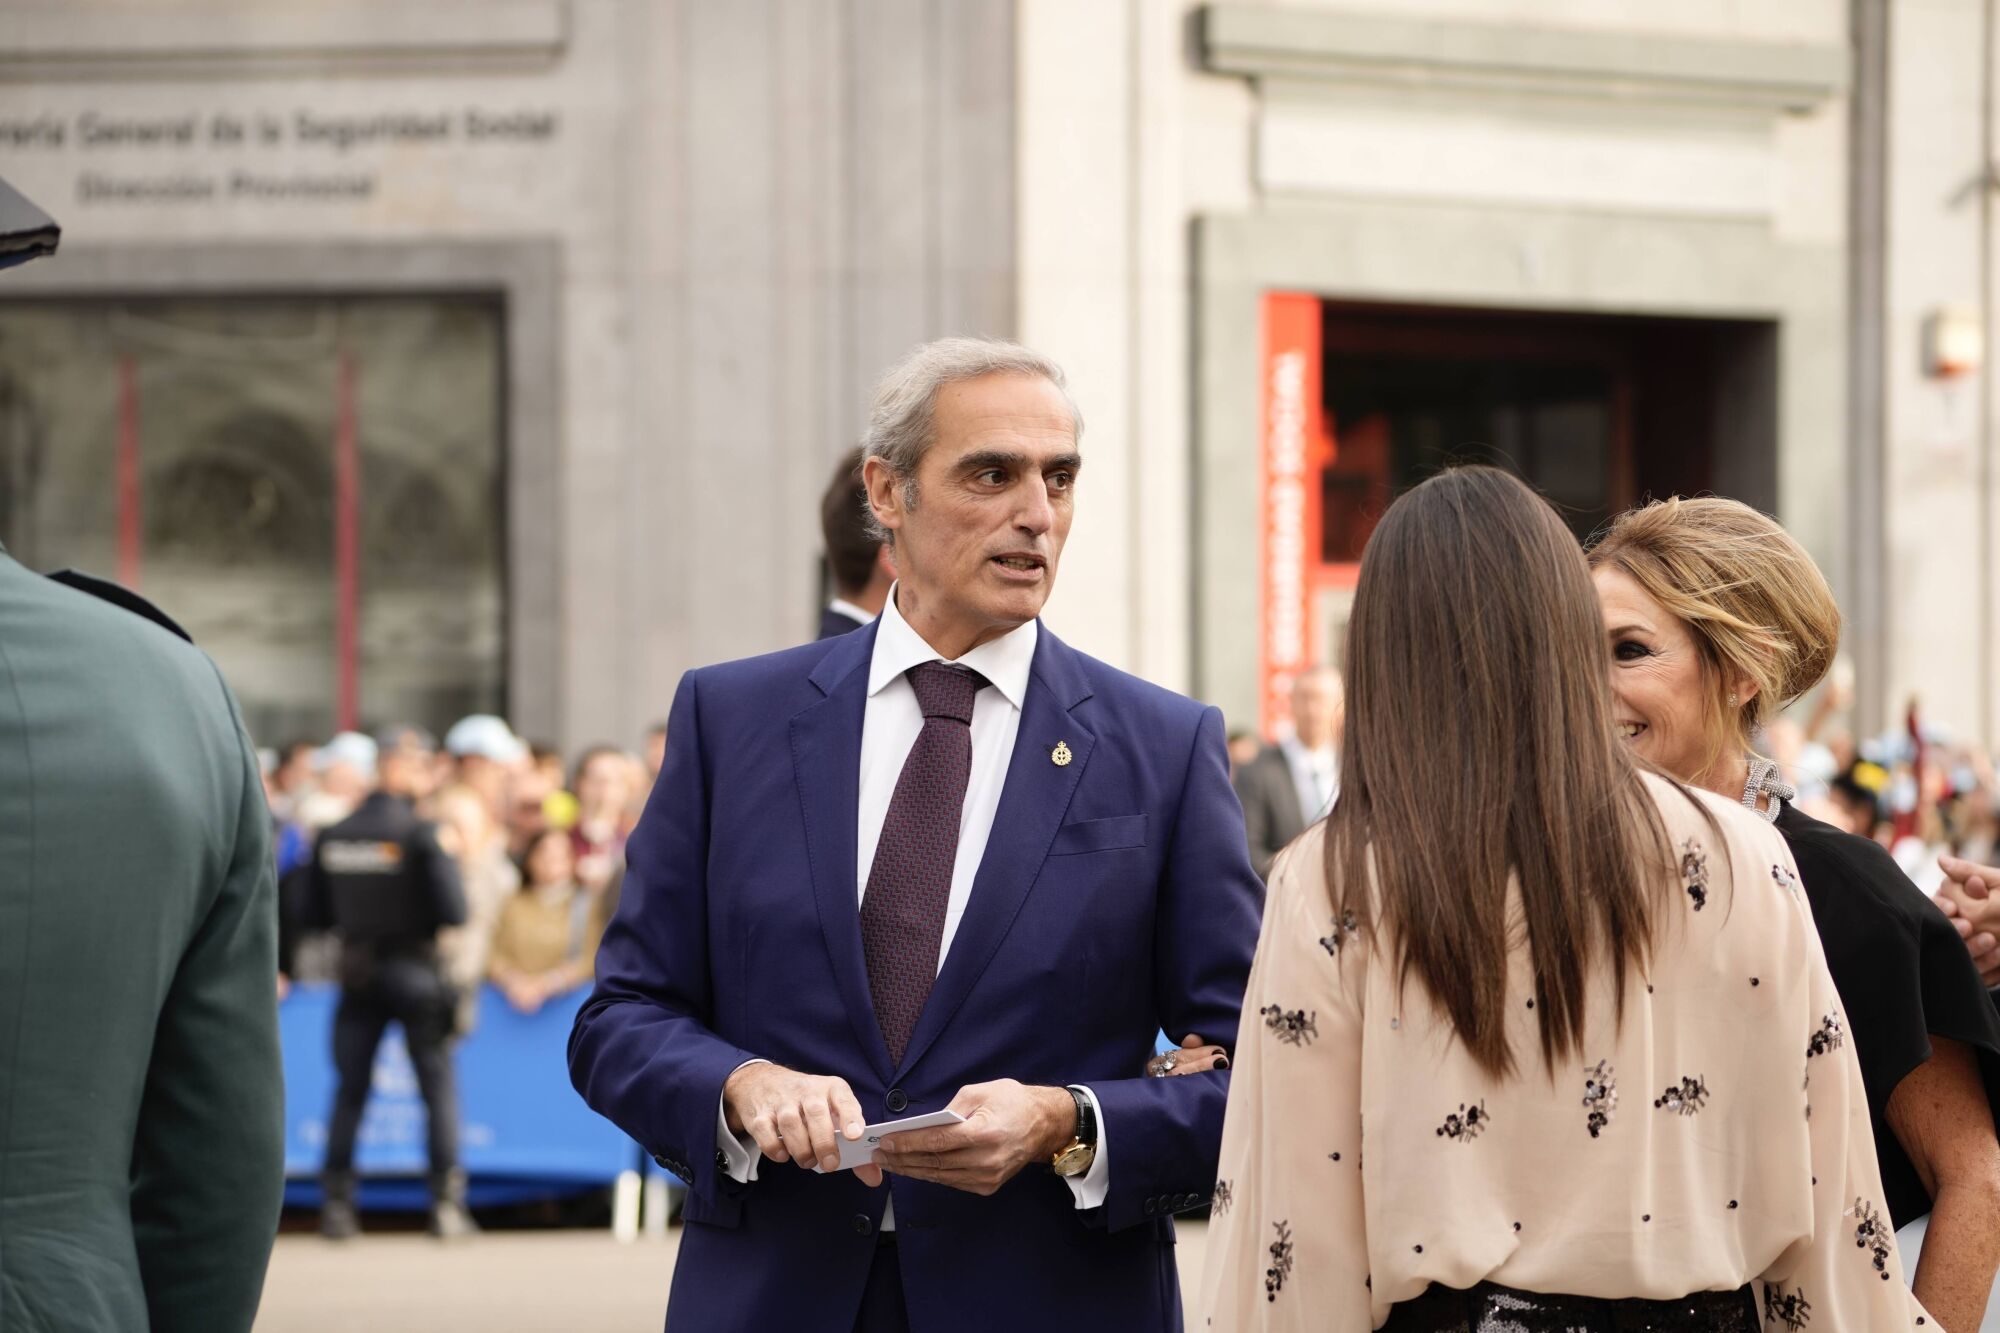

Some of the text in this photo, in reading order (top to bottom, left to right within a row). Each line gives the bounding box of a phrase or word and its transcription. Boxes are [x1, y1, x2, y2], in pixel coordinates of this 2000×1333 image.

[78, 112, 199, 148] General
[206, 111, 249, 146] de
[255, 111, 286, 145] la
[292, 109, 454, 153] Seguridad
[461, 108, 557, 142] Social
[228, 171, 375, 202] Provincial
